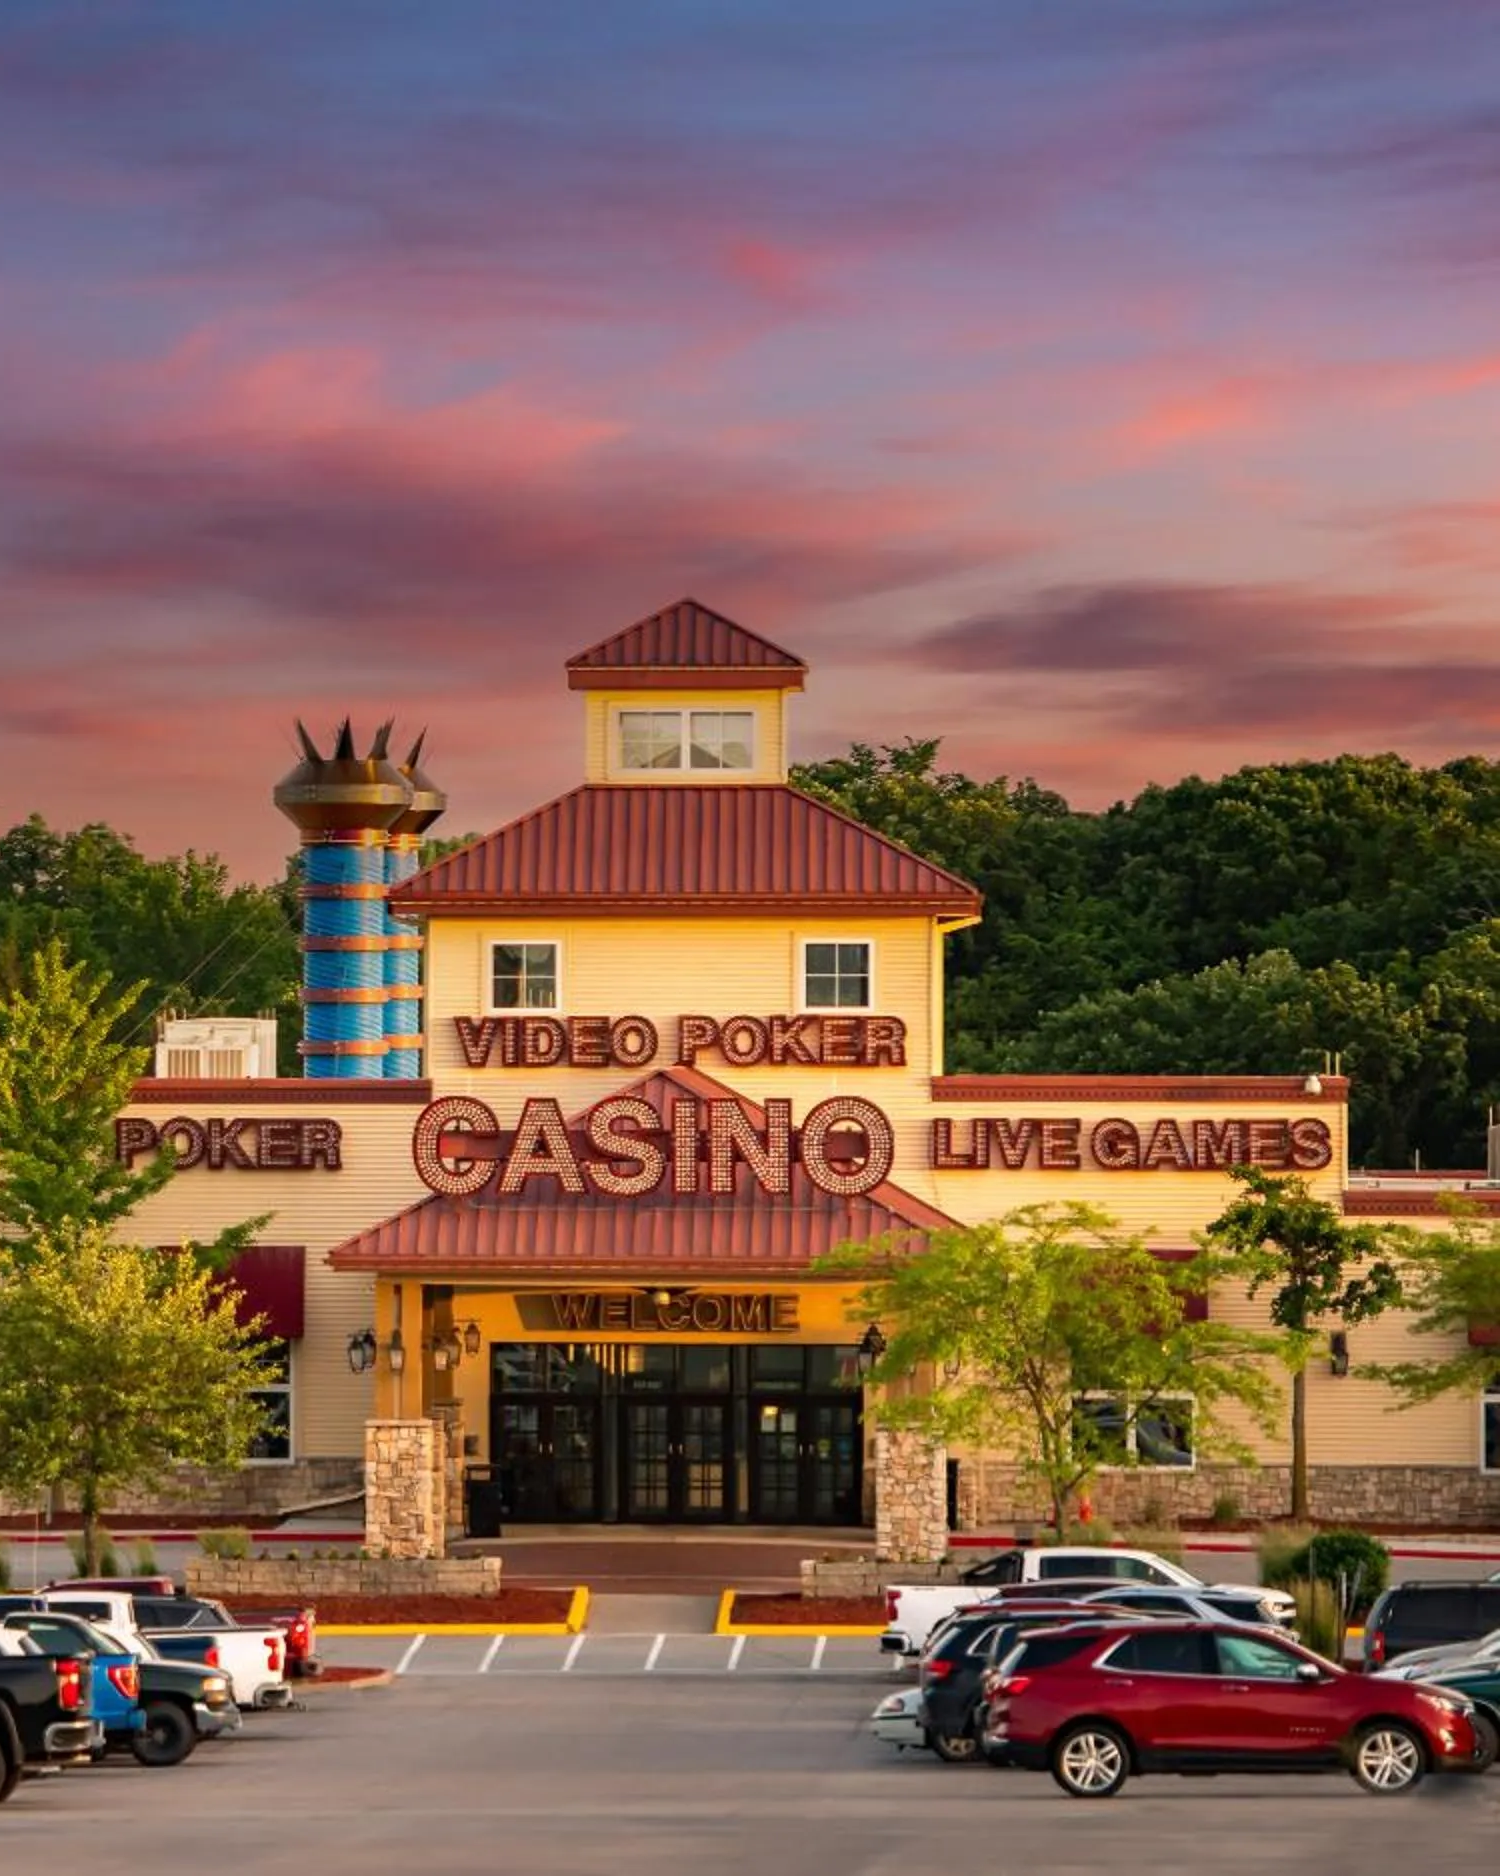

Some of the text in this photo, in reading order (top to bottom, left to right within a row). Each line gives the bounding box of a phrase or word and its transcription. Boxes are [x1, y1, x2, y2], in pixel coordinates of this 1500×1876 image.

[454, 1015, 907, 1067] VIDEO POKER
[115, 1116, 343, 1171] POKER
[413, 1096, 895, 1197] CASINO
[933, 1117, 1333, 1171] LIVE GAMES
[551, 1292, 800, 1331] WELCOME
